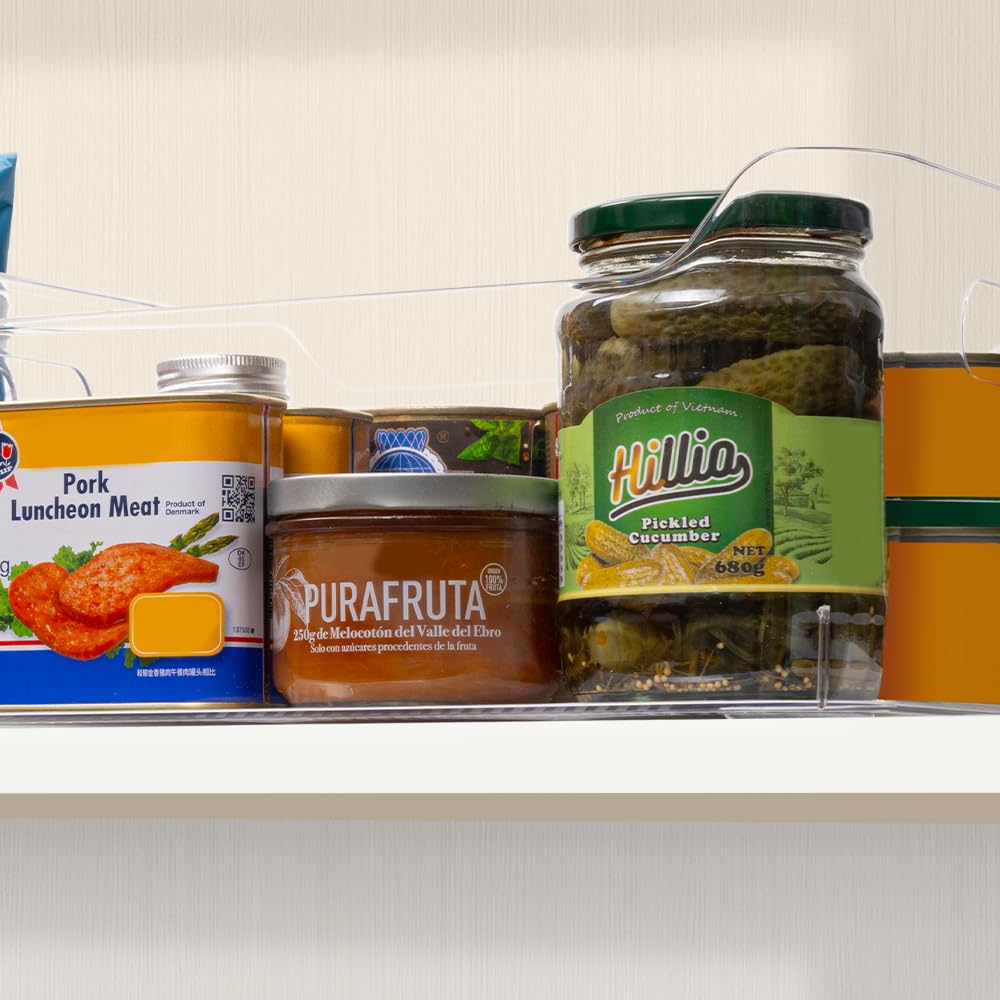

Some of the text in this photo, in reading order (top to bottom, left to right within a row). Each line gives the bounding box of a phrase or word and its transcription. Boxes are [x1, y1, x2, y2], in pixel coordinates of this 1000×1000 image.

[615, 400, 739, 424] Product of Vietnam
[609, 427, 752, 510] Hillia
[63, 470, 109, 495] Pork
[11, 495, 160, 522] Luncheon Meat
[165, 499, 206, 509] Product of
[165, 507, 200, 517] Denmark
[641, 515, 711, 532] Pickled
[628, 530, 721, 545] Cucumber
[732, 545, 766, 557] NET
[714, 559, 766, 577] 680g
[304, 580, 487, 624] PURAFRUTA
[293, 624, 501, 645] 250g de Melocotón del Valle del Ebro
[326, 645, 340, 653] con
[341, 642, 376, 653] azúcares
[378, 642, 432, 654] procedentes
[434, 641, 446, 651] de
[447, 641, 455, 651] la
[456, 641, 477, 651] fruta
